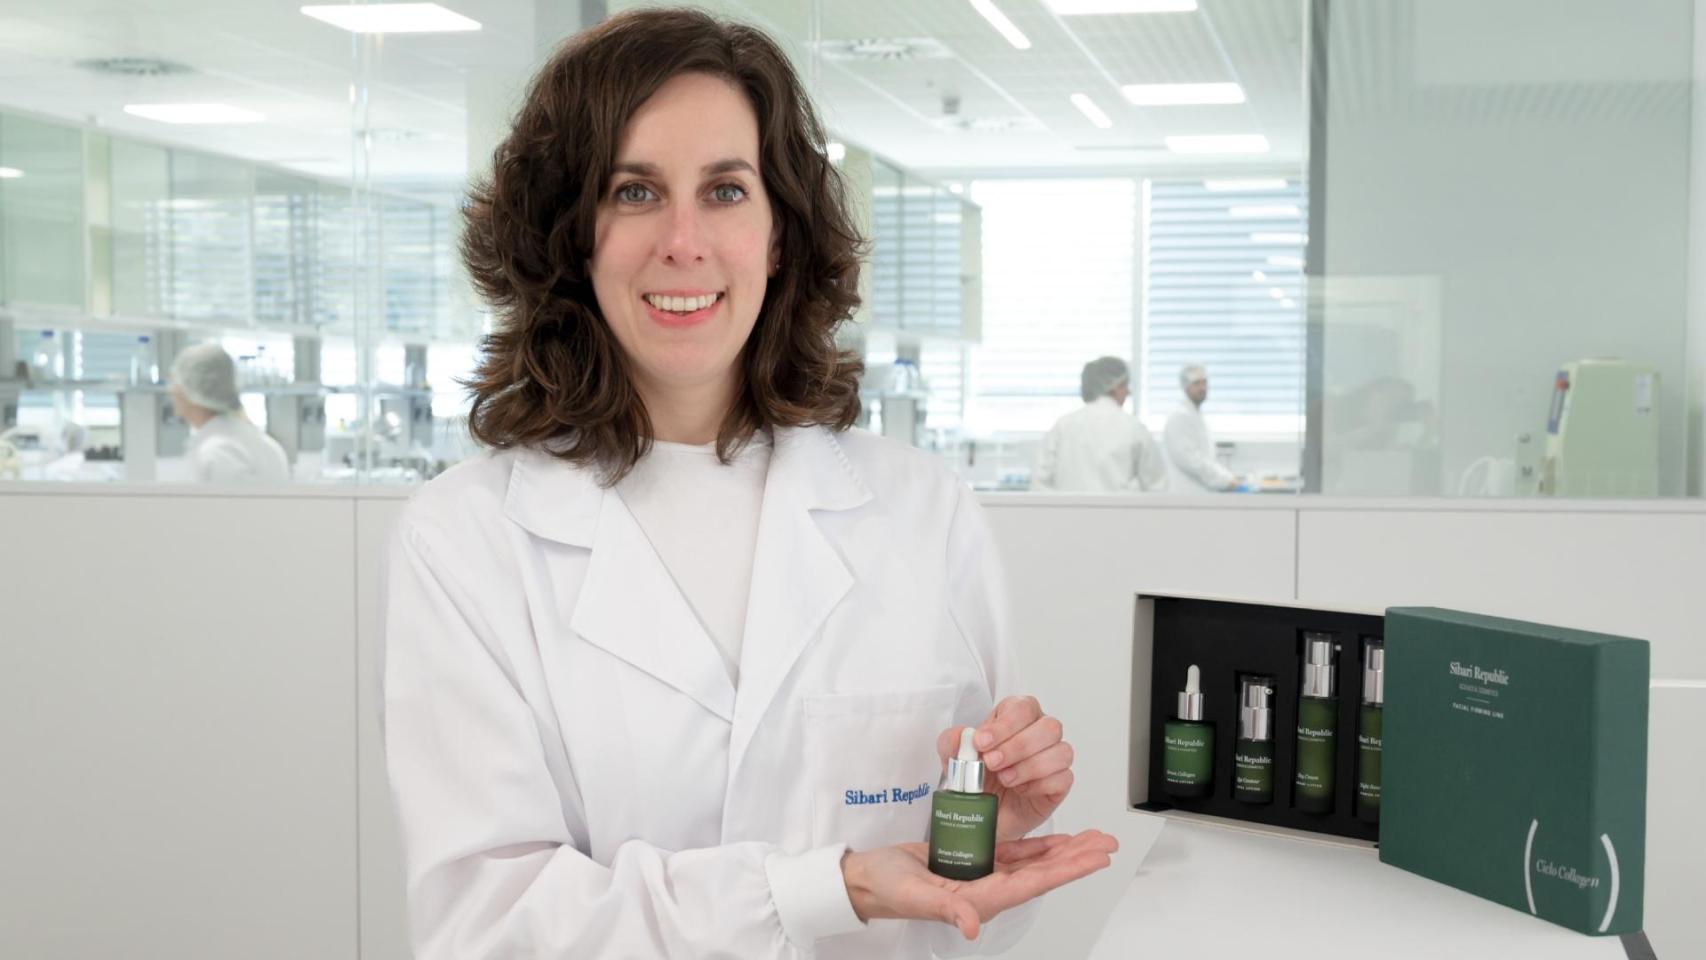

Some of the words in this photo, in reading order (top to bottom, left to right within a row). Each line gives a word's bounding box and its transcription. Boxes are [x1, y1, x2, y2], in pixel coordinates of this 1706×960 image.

[1449, 661, 1473, 678] Sibari
[1474, 665, 1509, 685] Republic
[845, 788, 888, 805] Sibari
[892, 783, 930, 804] Republic
[953, 811, 984, 824] Republic
